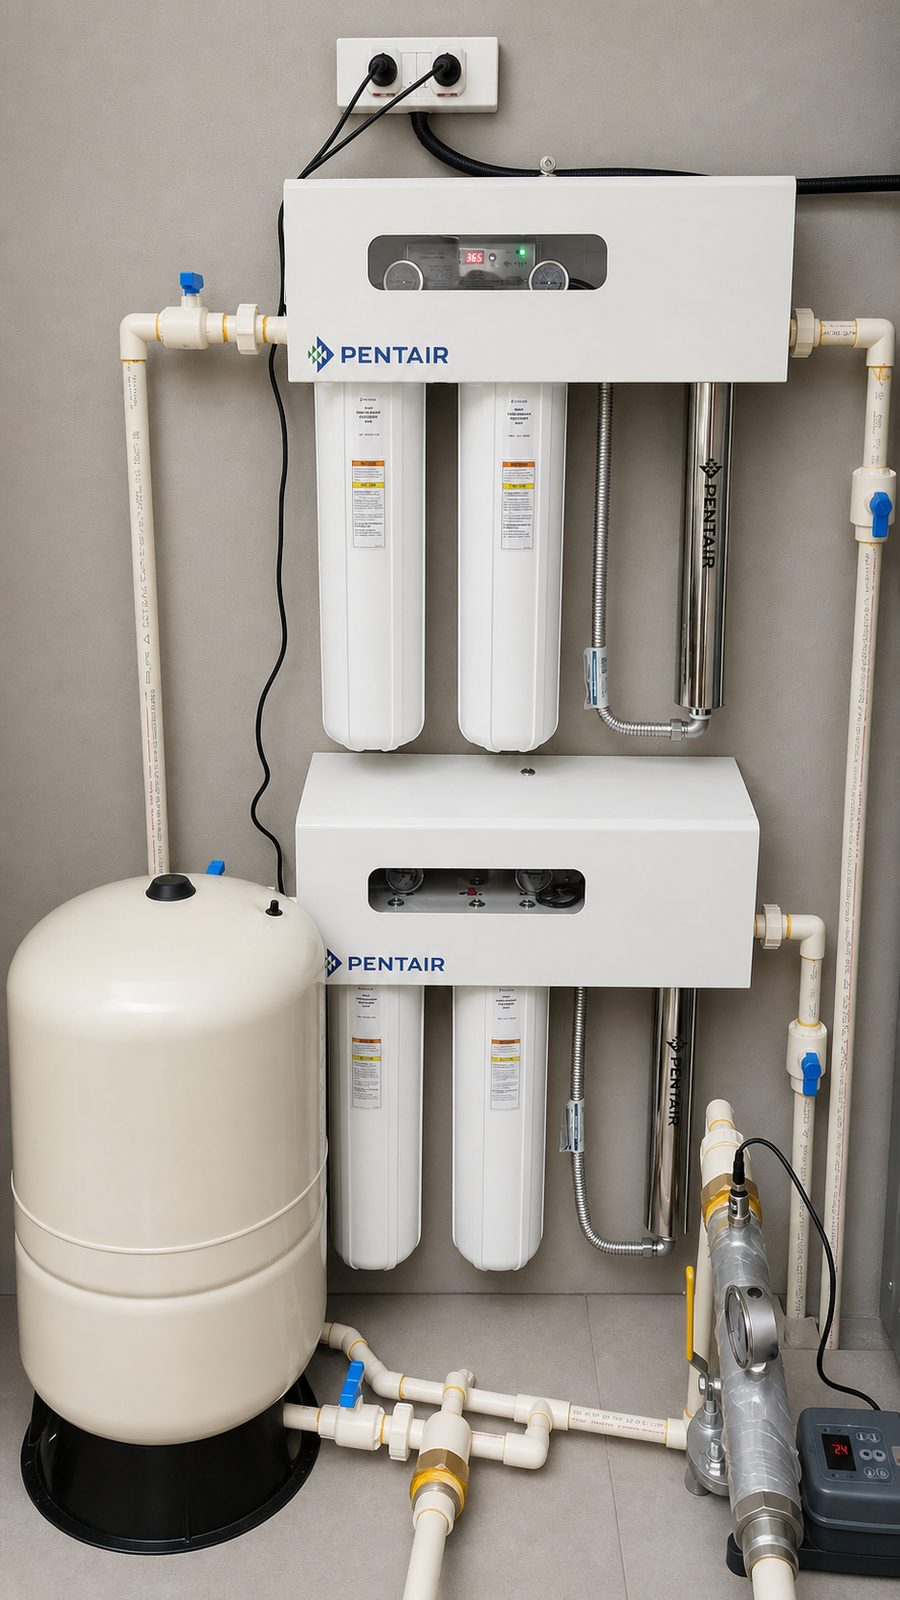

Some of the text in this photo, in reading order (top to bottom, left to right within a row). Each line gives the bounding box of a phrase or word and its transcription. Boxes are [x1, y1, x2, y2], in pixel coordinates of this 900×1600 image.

[466, 252, 483, 263] 365
[341, 346, 449, 364] PENTAIR
[702, 484, 717, 569] PENTAIR
[347, 956, 446, 972] PENTAIR
[667, 1056, 683, 1127] PENTAIR
[831, 1443, 849, 1456] 24
